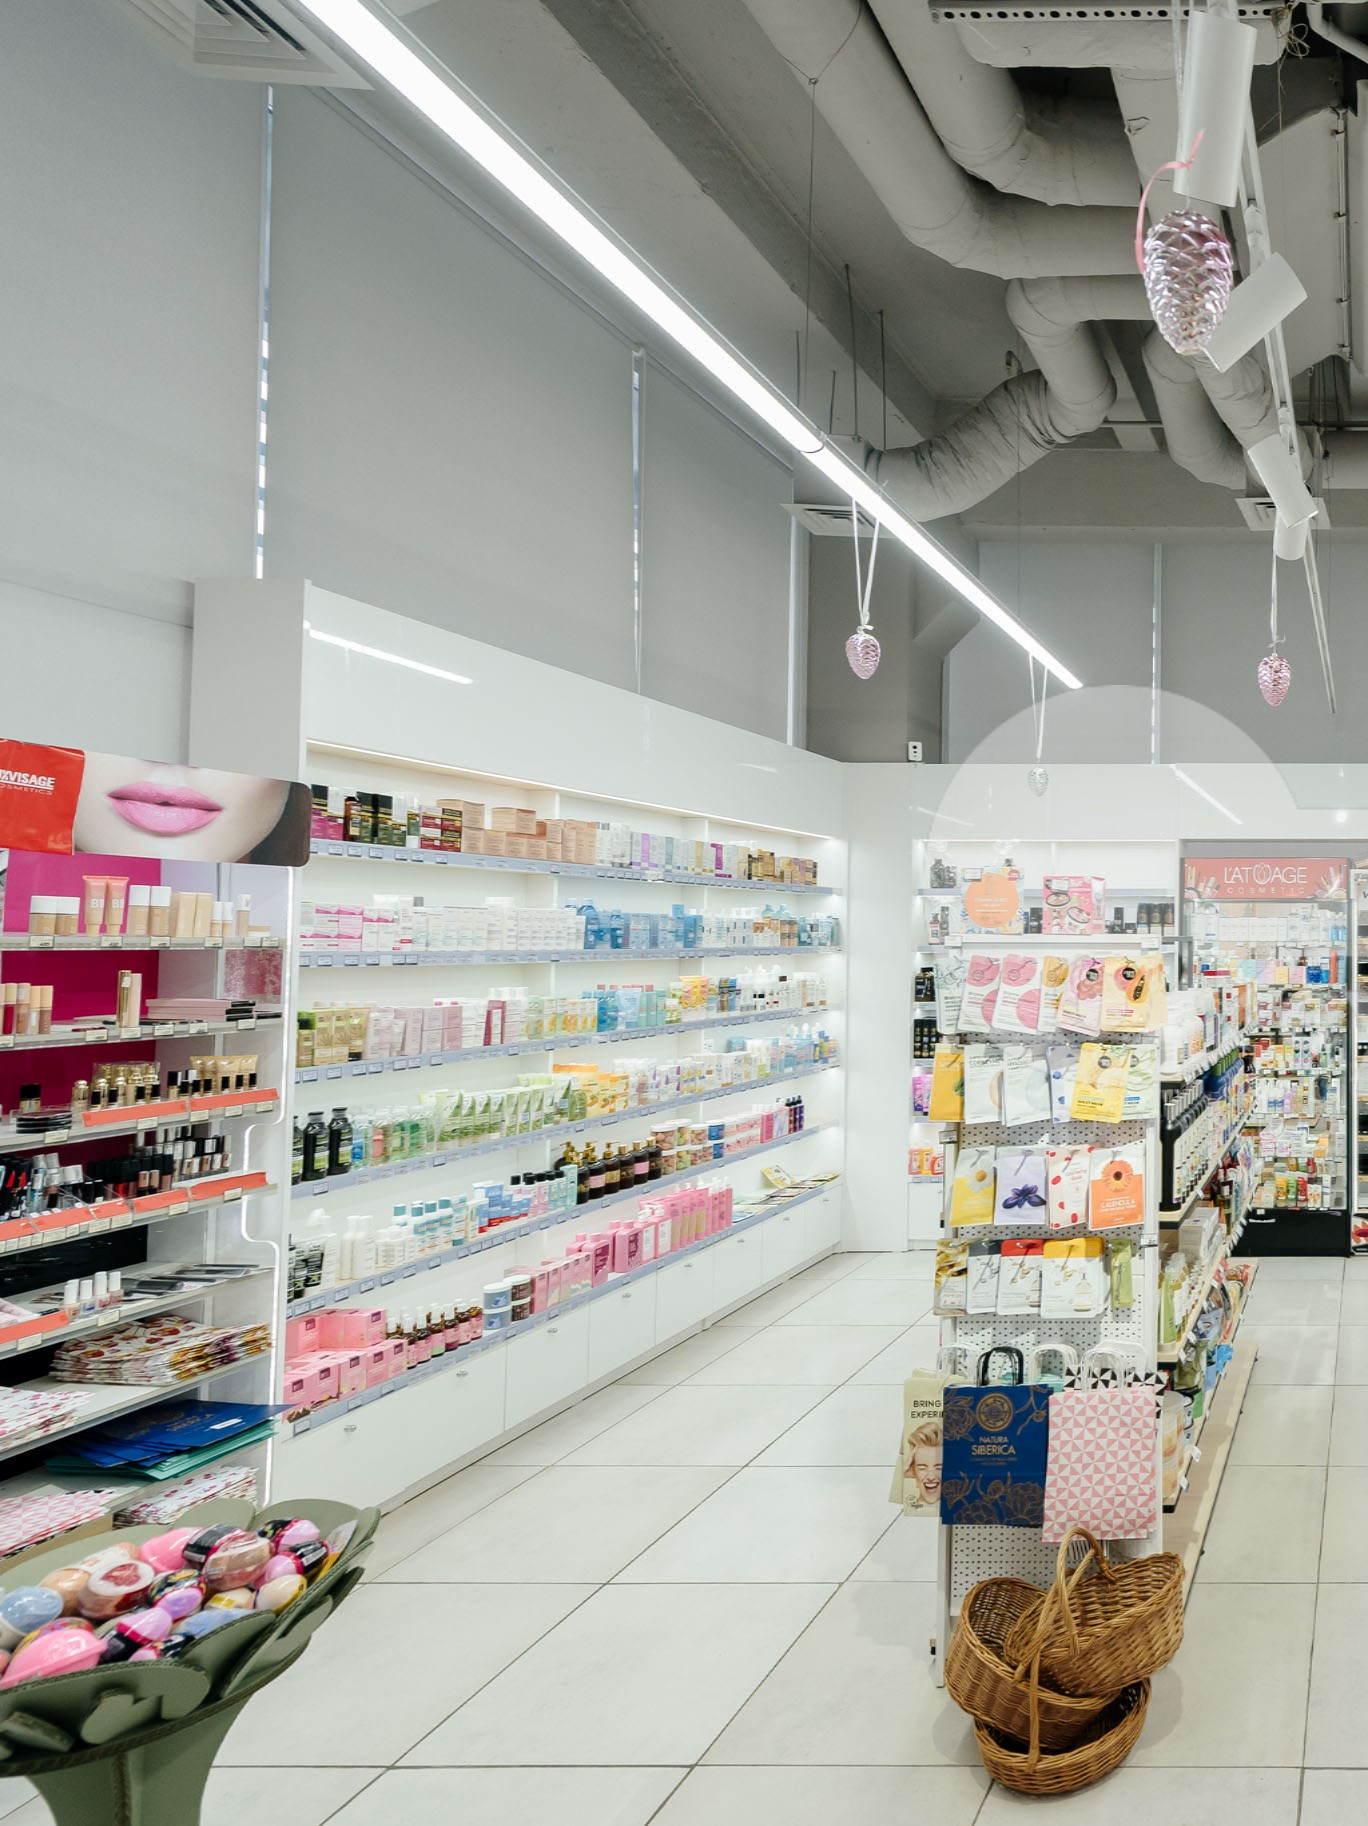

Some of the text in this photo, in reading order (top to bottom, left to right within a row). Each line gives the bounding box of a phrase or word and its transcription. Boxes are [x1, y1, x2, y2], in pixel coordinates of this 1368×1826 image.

[1228, 887, 1305, 895] COSMETIC
[913, 1400, 942, 1408] BRING
[910, 1411, 944, 1419] EXPERI
[971, 1445, 1016, 1455] SIBERICA
